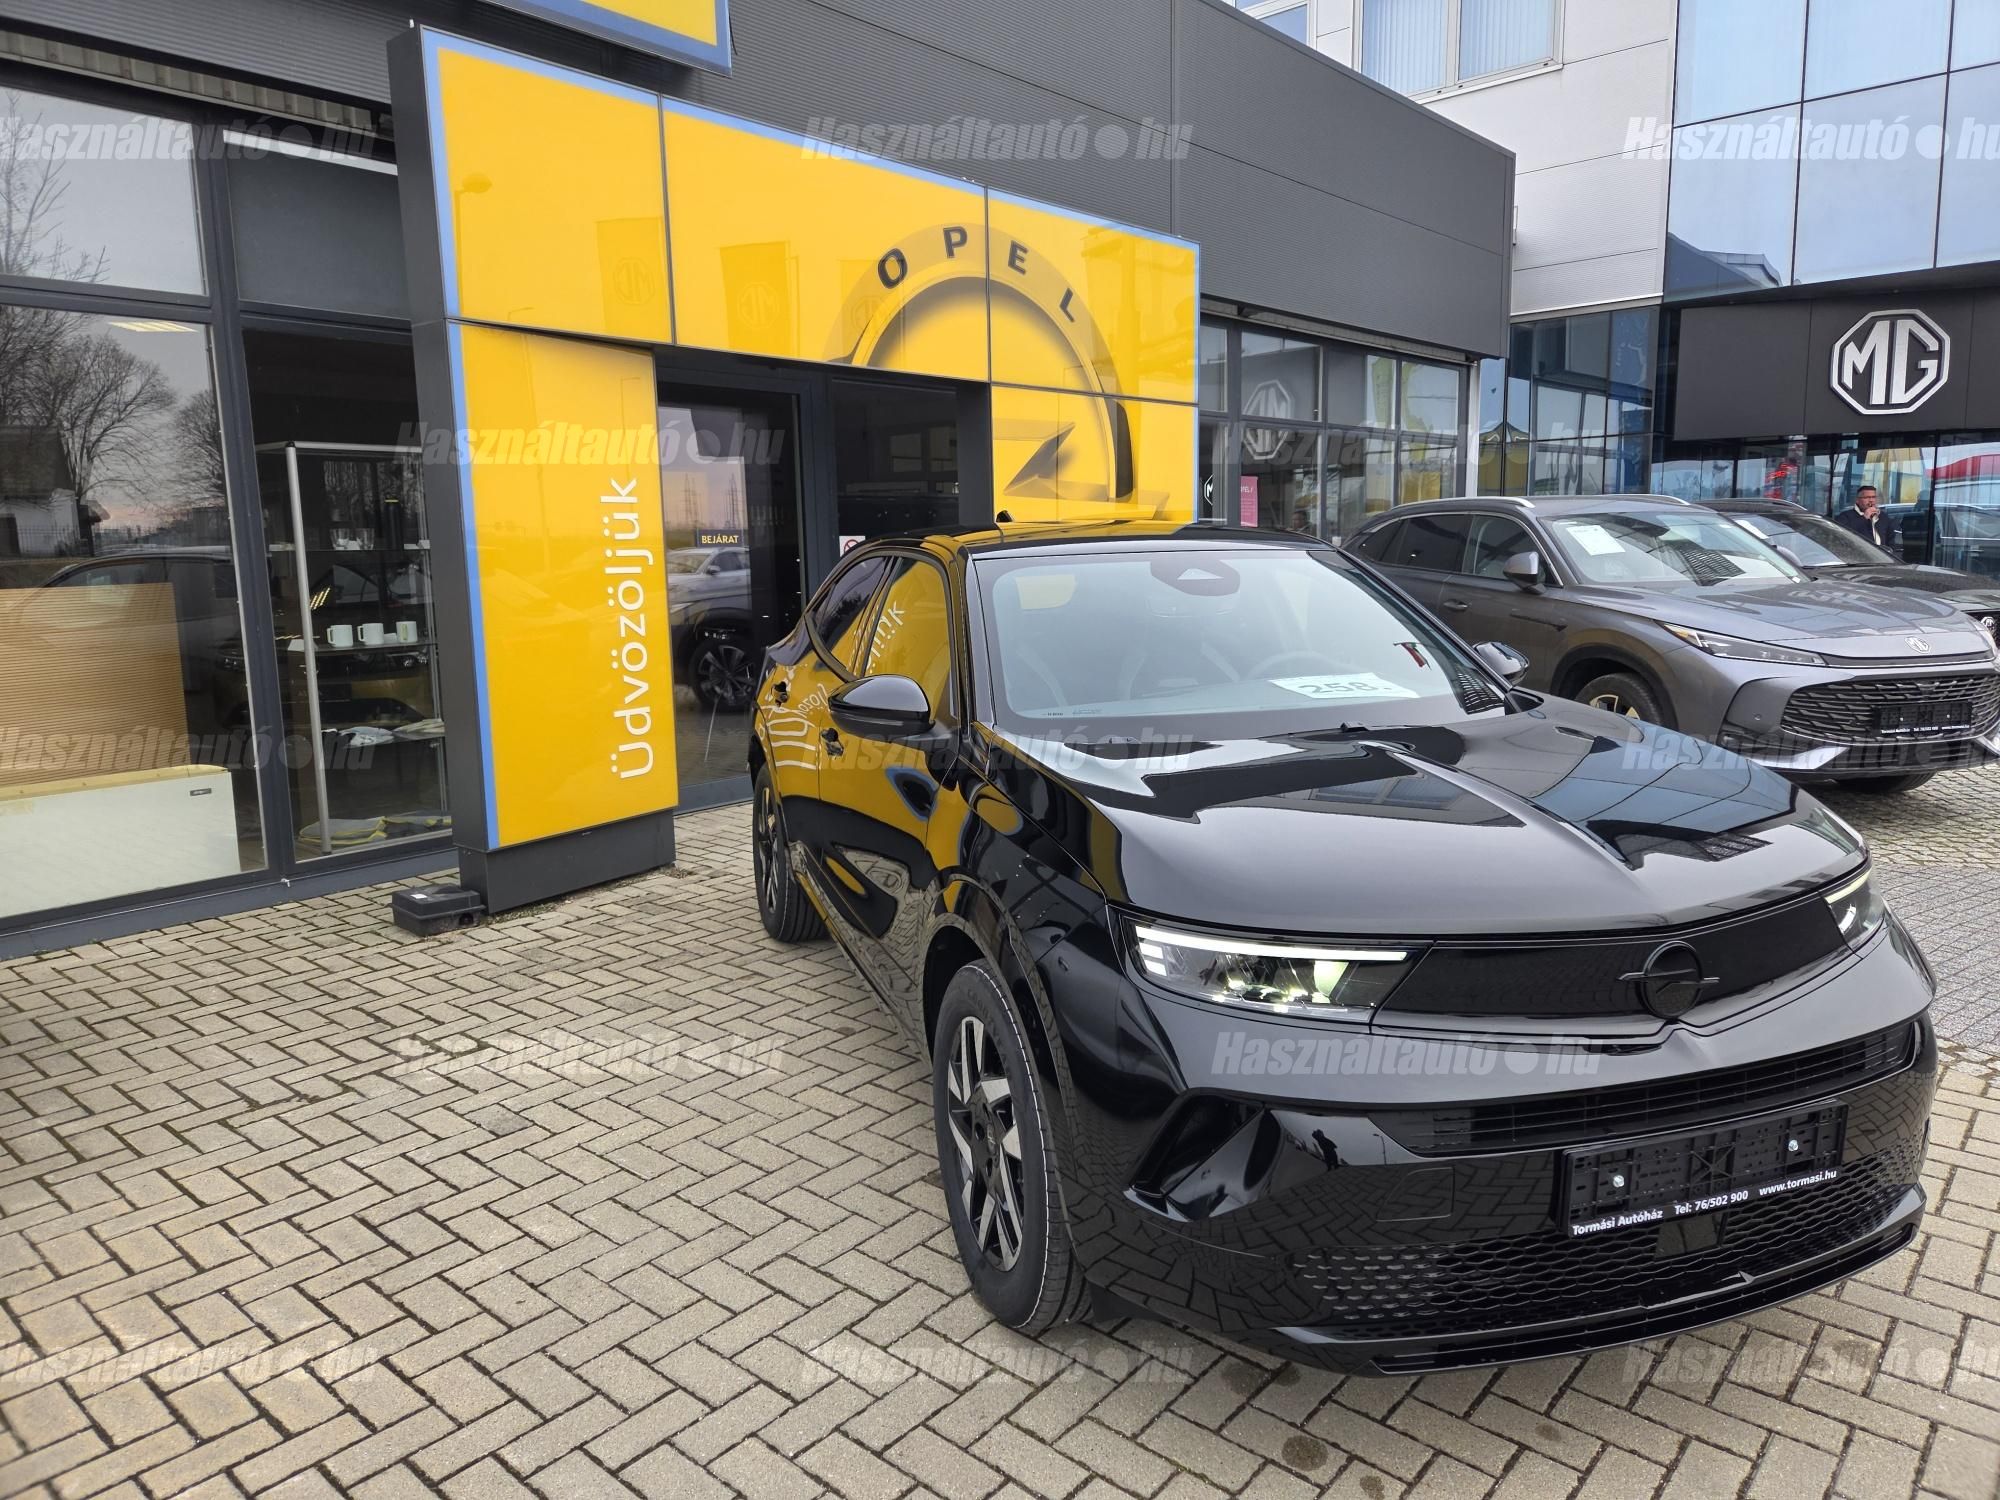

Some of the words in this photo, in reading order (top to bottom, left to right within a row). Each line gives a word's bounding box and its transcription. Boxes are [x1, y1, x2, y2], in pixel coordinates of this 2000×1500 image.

[878, 226, 1074, 322] OPEL
[1842, 319, 1940, 405] MG
[701, 533, 739, 544] BEJÁRAT
[600, 478, 654, 779] Üdvözöljük
[1572, 1216, 1616, 1236] Tormási
[1618, 1208, 1663, 1227] Autóház
[1674, 1203, 1692, 1215] Tel:
[1695, 1197, 1728, 1212] 76/502
[1730, 1190, 1748, 1204] 900
[1759, 1168, 1837, 1196] www.tormasi.hu
